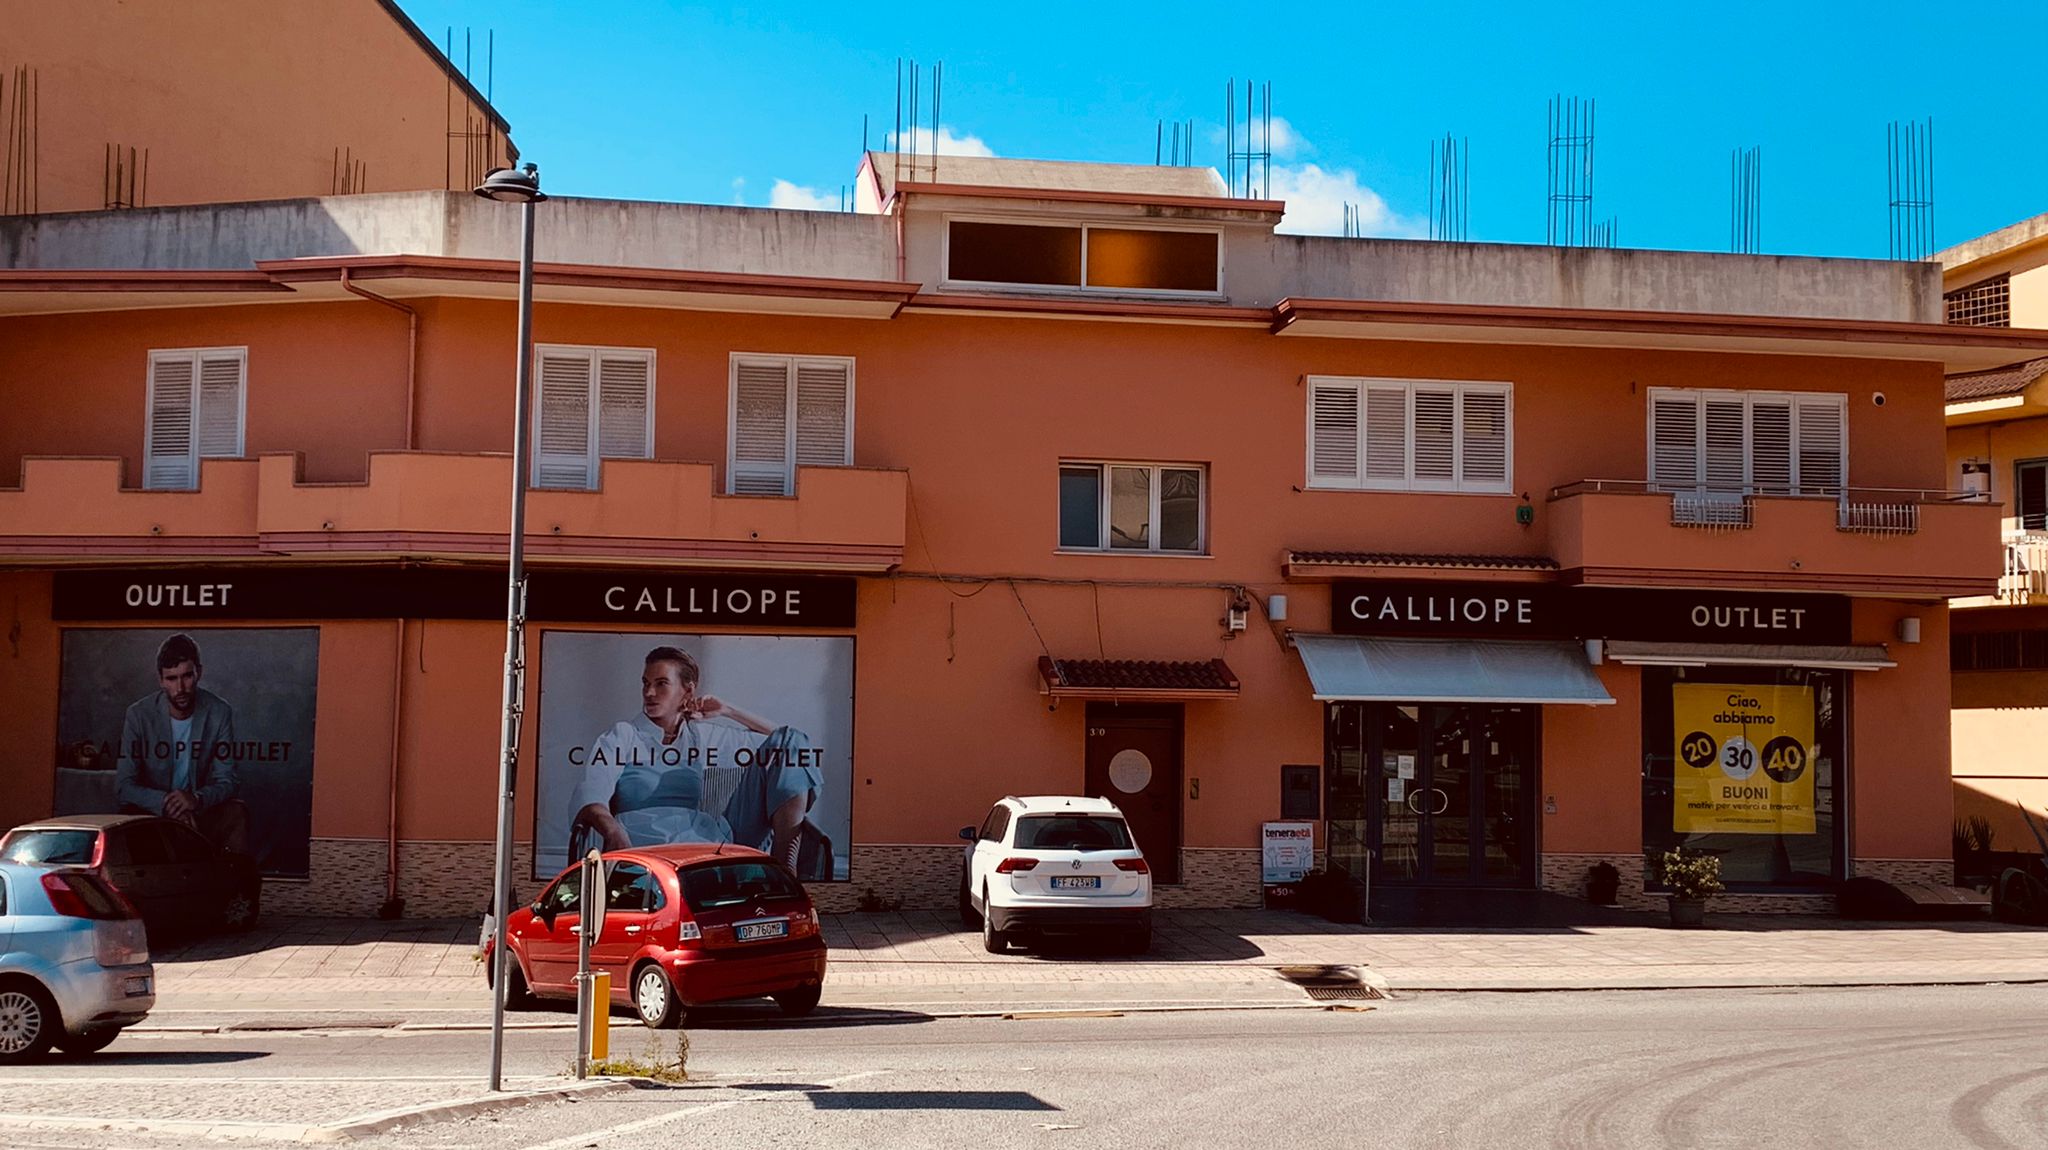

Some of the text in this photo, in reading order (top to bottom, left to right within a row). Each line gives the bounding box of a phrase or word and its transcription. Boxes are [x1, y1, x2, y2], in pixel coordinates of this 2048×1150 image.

[126, 584, 233, 607] OUTLET
[604, 586, 801, 615] CALLIOPE
[1350, 595, 1533, 624] CALLIOPE
[1691, 605, 1807, 630] OUTLET
[1727, 695, 1761, 709] Ciao,
[1713, 711, 1775, 724] abbiamo
[80, 740, 292, 762] CALLIOPE OUTLET
[568, 747, 824, 768] CALLIOPE OUTLET
[1685, 738, 1801, 771] 20 30 40
[1722, 786, 1768, 799] BUONI
[742, 926, 753, 938] DP
[756, 923, 781, 937] 760MP
